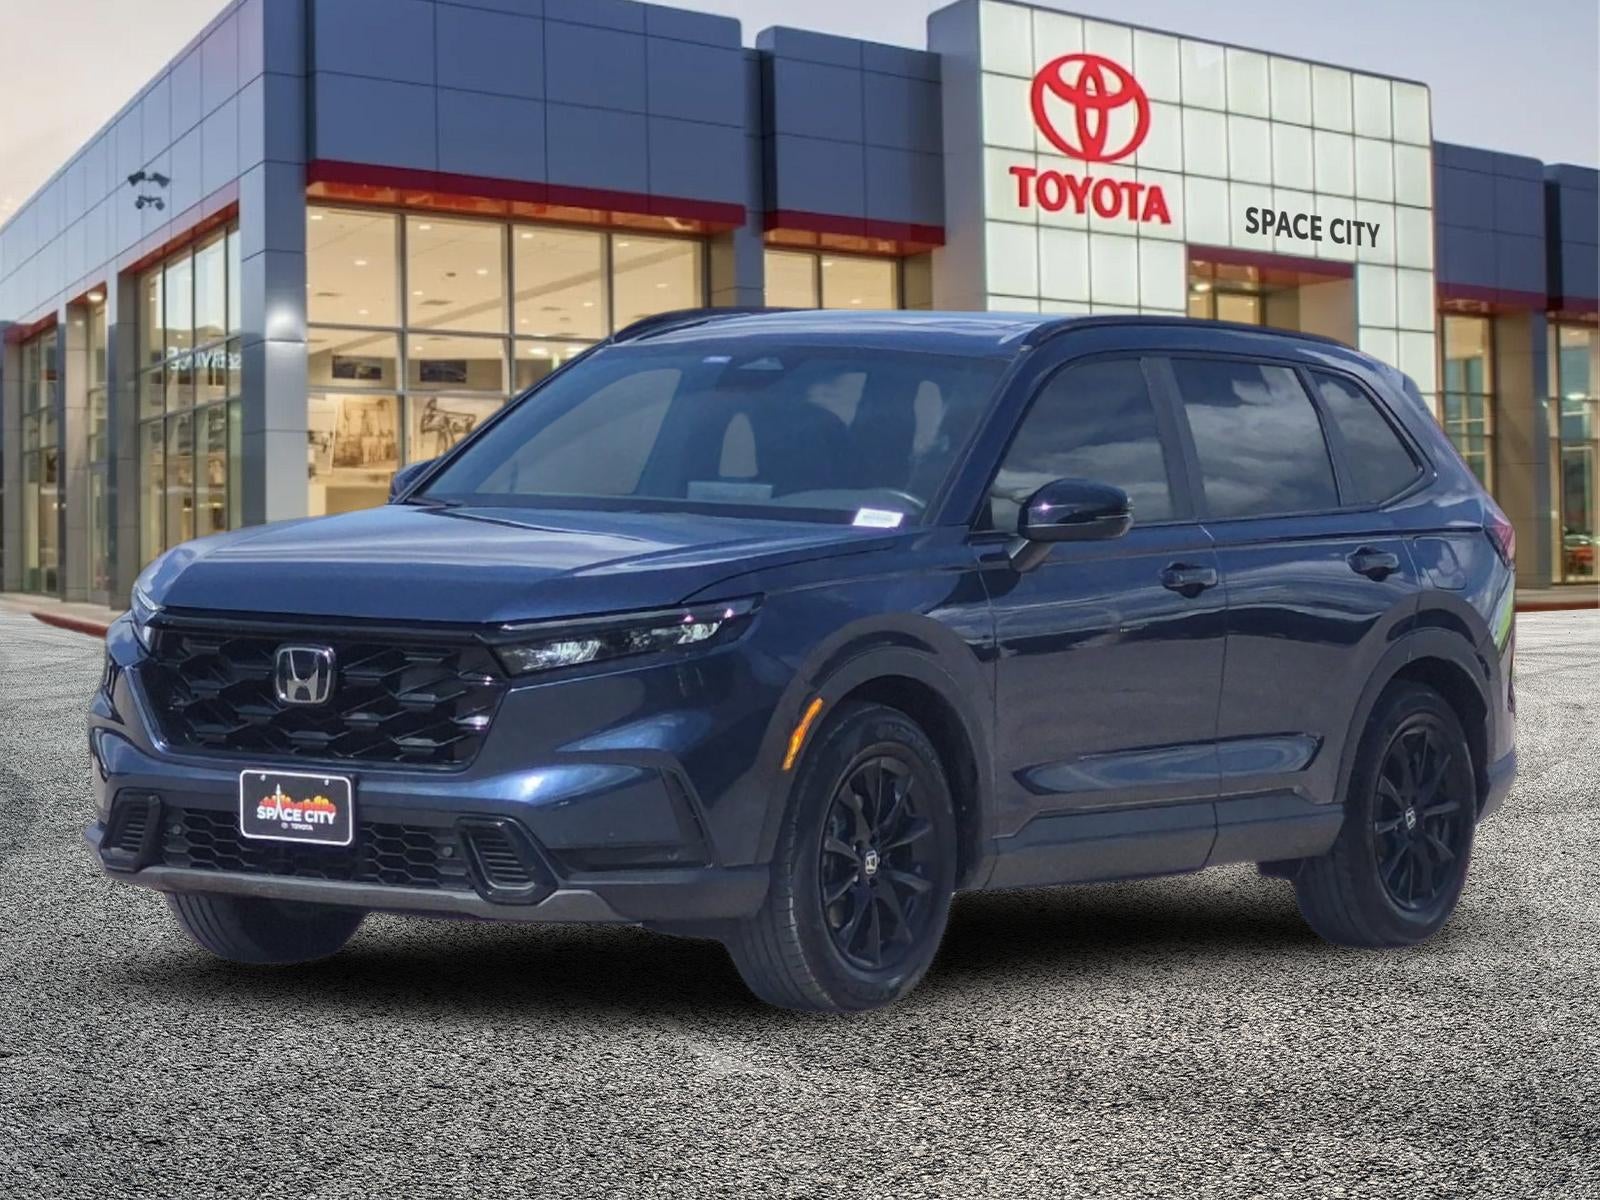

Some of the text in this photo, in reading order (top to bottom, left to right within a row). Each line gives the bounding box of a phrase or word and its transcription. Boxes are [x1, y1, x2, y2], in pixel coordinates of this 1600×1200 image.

[1009, 166, 1172, 225] TOYOTA
[1245, 206, 1381, 248] SPACE CITY
[256, 804, 336, 825] SPACE CITY
